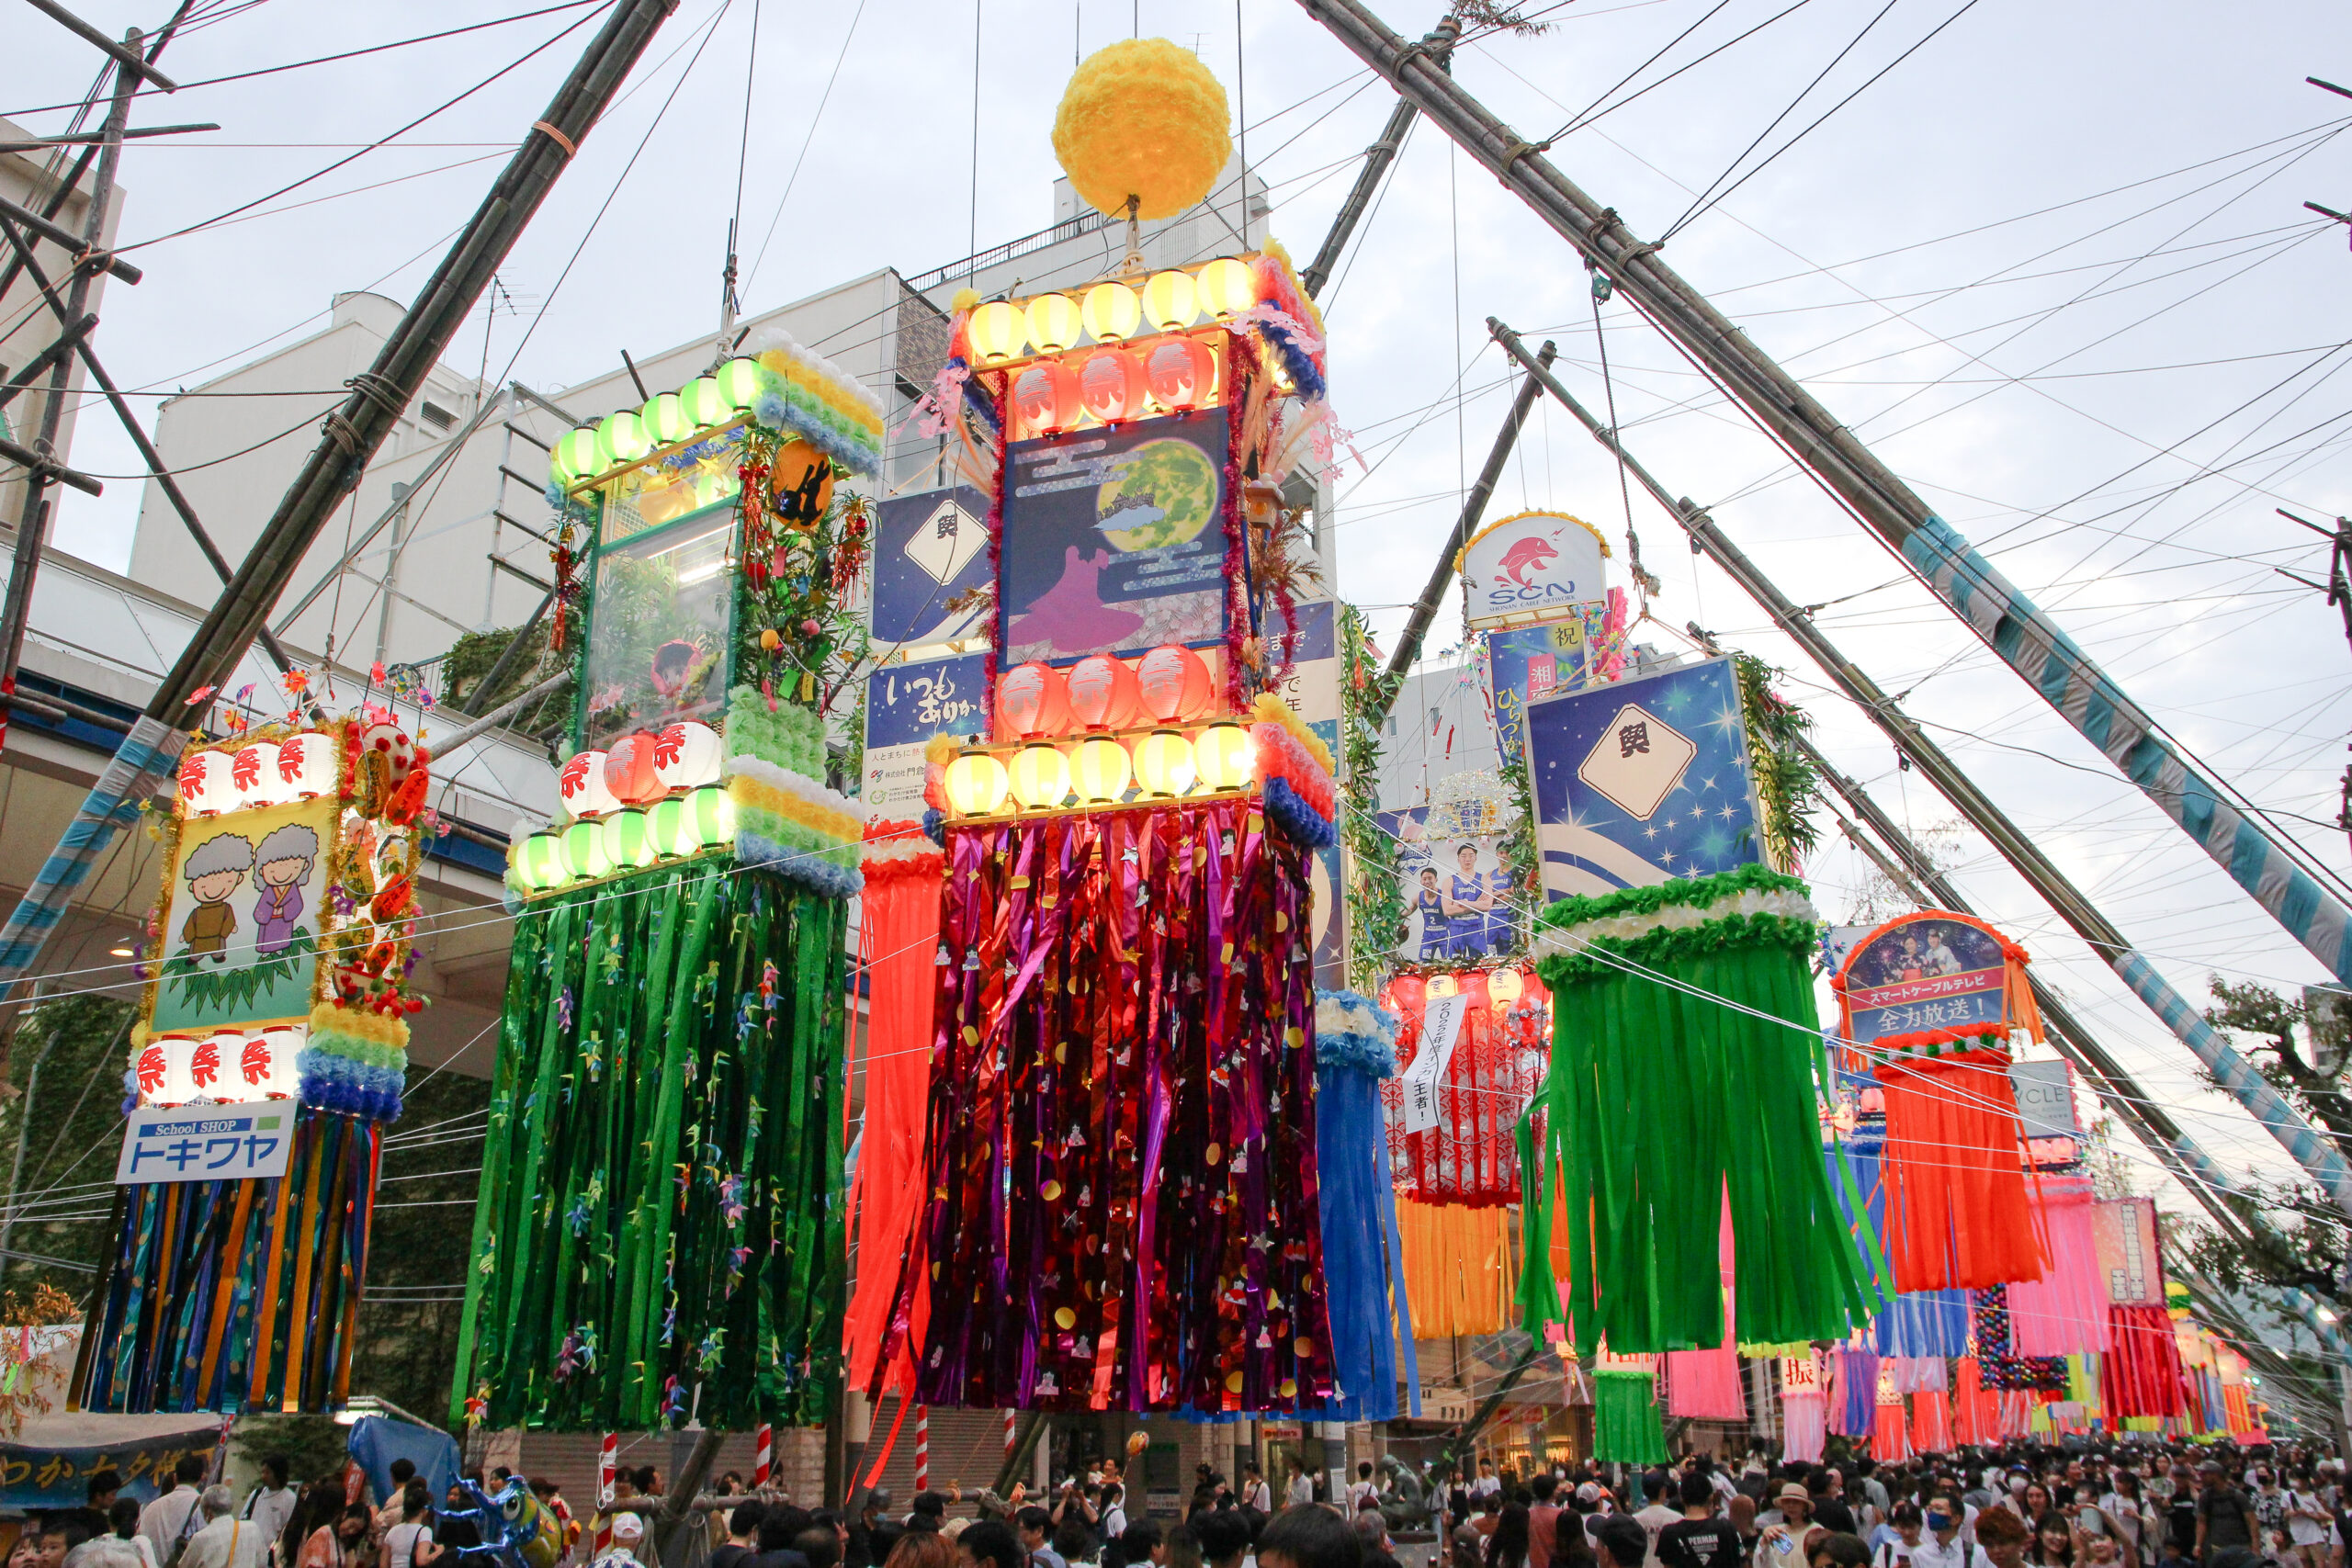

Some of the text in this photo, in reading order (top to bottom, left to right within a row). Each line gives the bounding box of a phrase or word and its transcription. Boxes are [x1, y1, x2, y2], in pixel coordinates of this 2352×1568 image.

[1488, 581, 1576, 604] SCN
[1489, 594, 1576, 612] SHONAN CABLE NETWORK
[1555, 626, 1578, 647] 祝
[887, 665, 956, 706] いつも
[278, 738, 305, 784] 祭
[653, 724, 686, 771] 祭
[180, 755, 207, 800] 祭
[232, 748, 261, 792] 祭
[560, 752, 591, 799] 祭
[1430, 917, 1436, 925] 2
[1870, 975, 1985, 1004] スマートケーブルテレビ
[137, 1046, 166, 1094] 祭
[191, 1043, 220, 1089] 祭
[241, 1039, 271, 1086] 祭
[155, 1120, 237, 1136] School SHOP
[130, 1134, 279, 1174] トキワヤ
